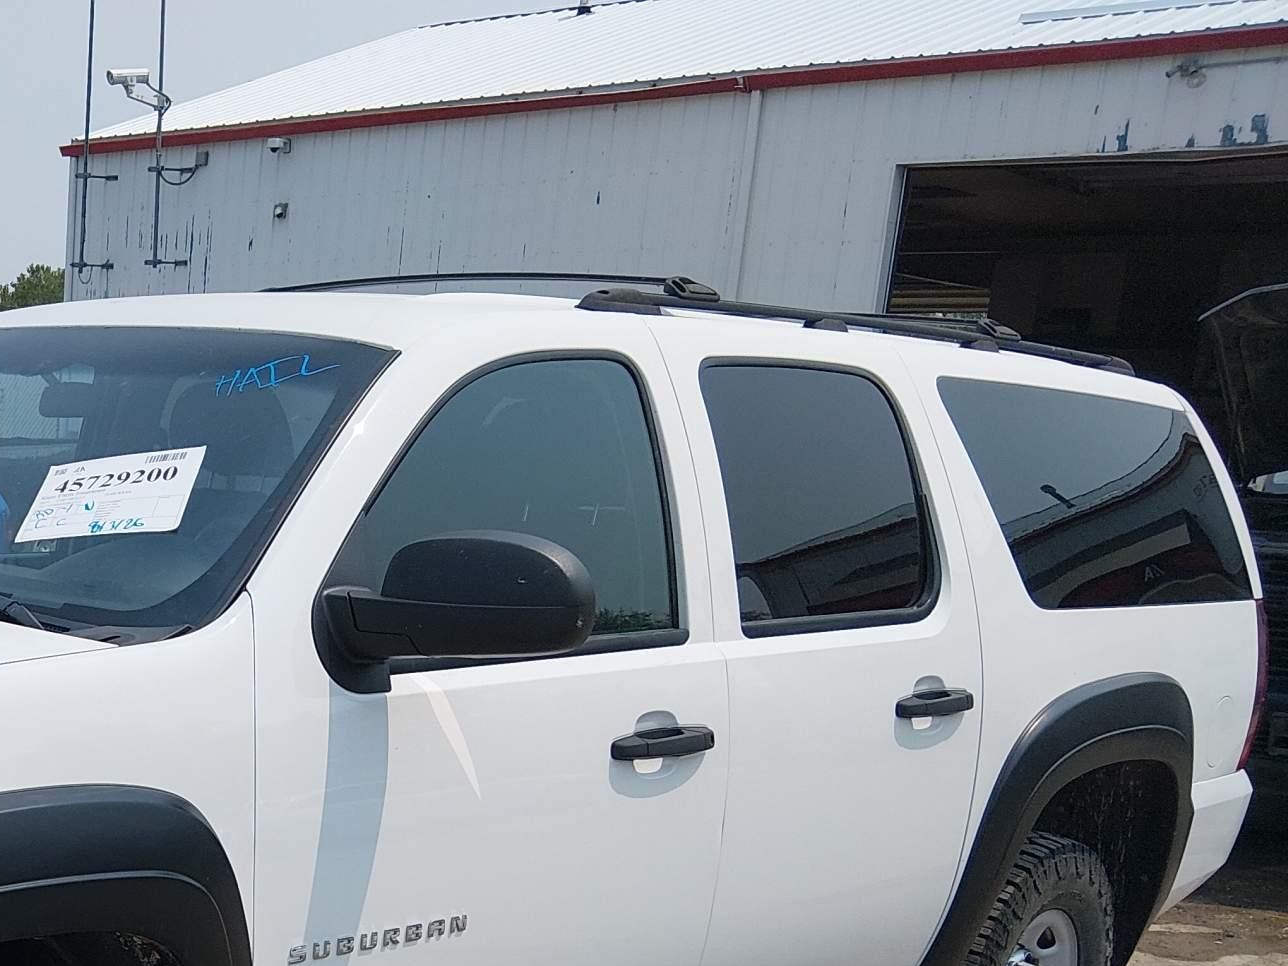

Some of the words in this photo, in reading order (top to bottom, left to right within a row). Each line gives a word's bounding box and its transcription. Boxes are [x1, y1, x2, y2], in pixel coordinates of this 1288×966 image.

[215, 354, 340, 397] HAIL
[55, 465, 178, 493] 45729200
[287, 914, 469, 966] SUBURBAN
